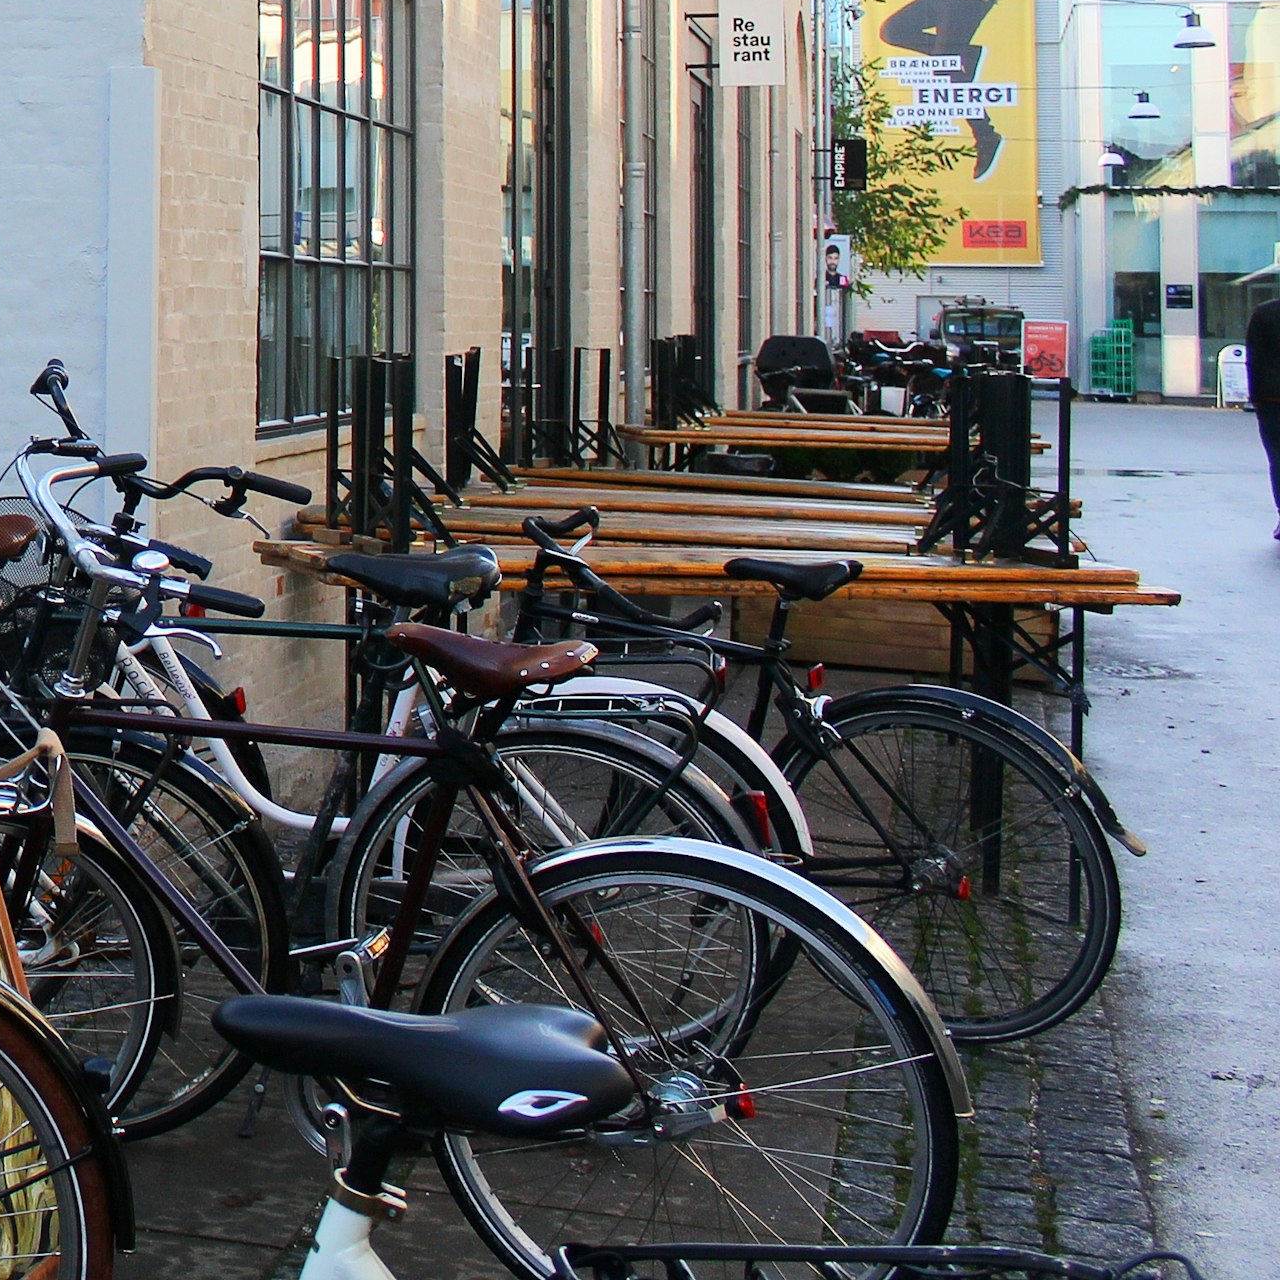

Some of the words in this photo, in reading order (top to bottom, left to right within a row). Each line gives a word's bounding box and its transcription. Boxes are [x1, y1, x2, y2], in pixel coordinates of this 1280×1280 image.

[733, 18, 755, 32] Re
[733, 34, 771, 47] stau
[733, 48, 770, 62] rant
[890, 59, 958, 68] BRÆNDER
[918, 87, 1012, 103] ENERGI
[896, 107, 981, 117] GRØNNERE?
[835, 146, 845, 188] EMPIRE
[120, 656, 156, 701] Rock
